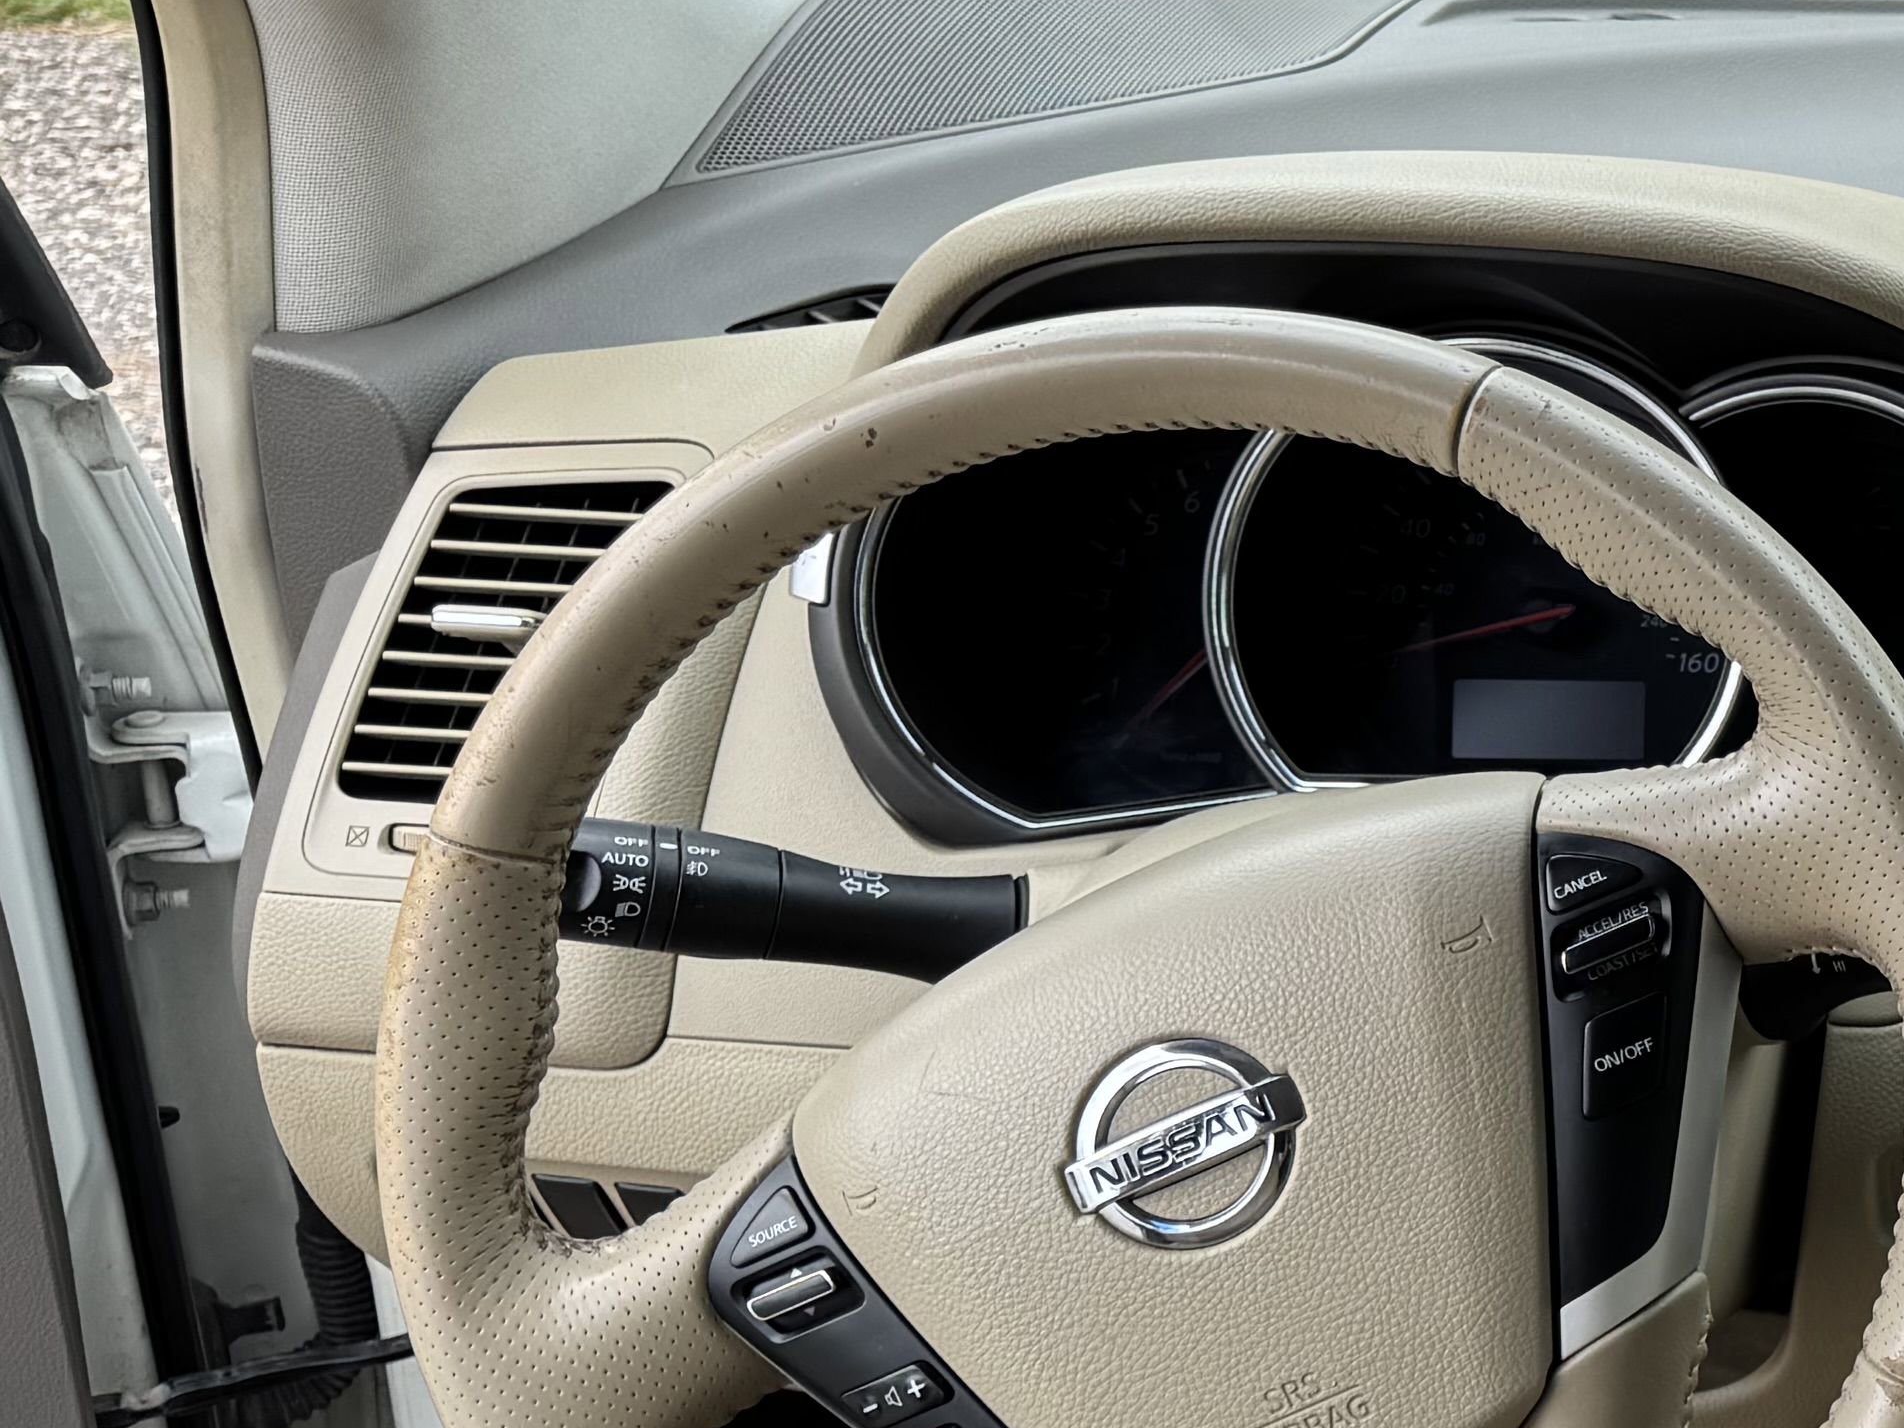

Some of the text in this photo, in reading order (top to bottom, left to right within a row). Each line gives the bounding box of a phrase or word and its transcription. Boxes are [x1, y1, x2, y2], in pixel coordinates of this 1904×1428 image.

[1680, 652, 1720, 674] 160
[614, 836, 649, 847] OFF
[687, 845, 720, 857] OFF
[601, 852, 649, 867] AUTO
[1553, 870, 1607, 899] CANCEL
[1578, 901, 1649, 940] ACCEL/RES
[1594, 1037, 1654, 1072] ON/OFF
[1089, 1092, 1276, 1193] NISSAN
[748, 1216, 798, 1248] SOURCE
[1263, 1372, 1322, 1414] SRS
